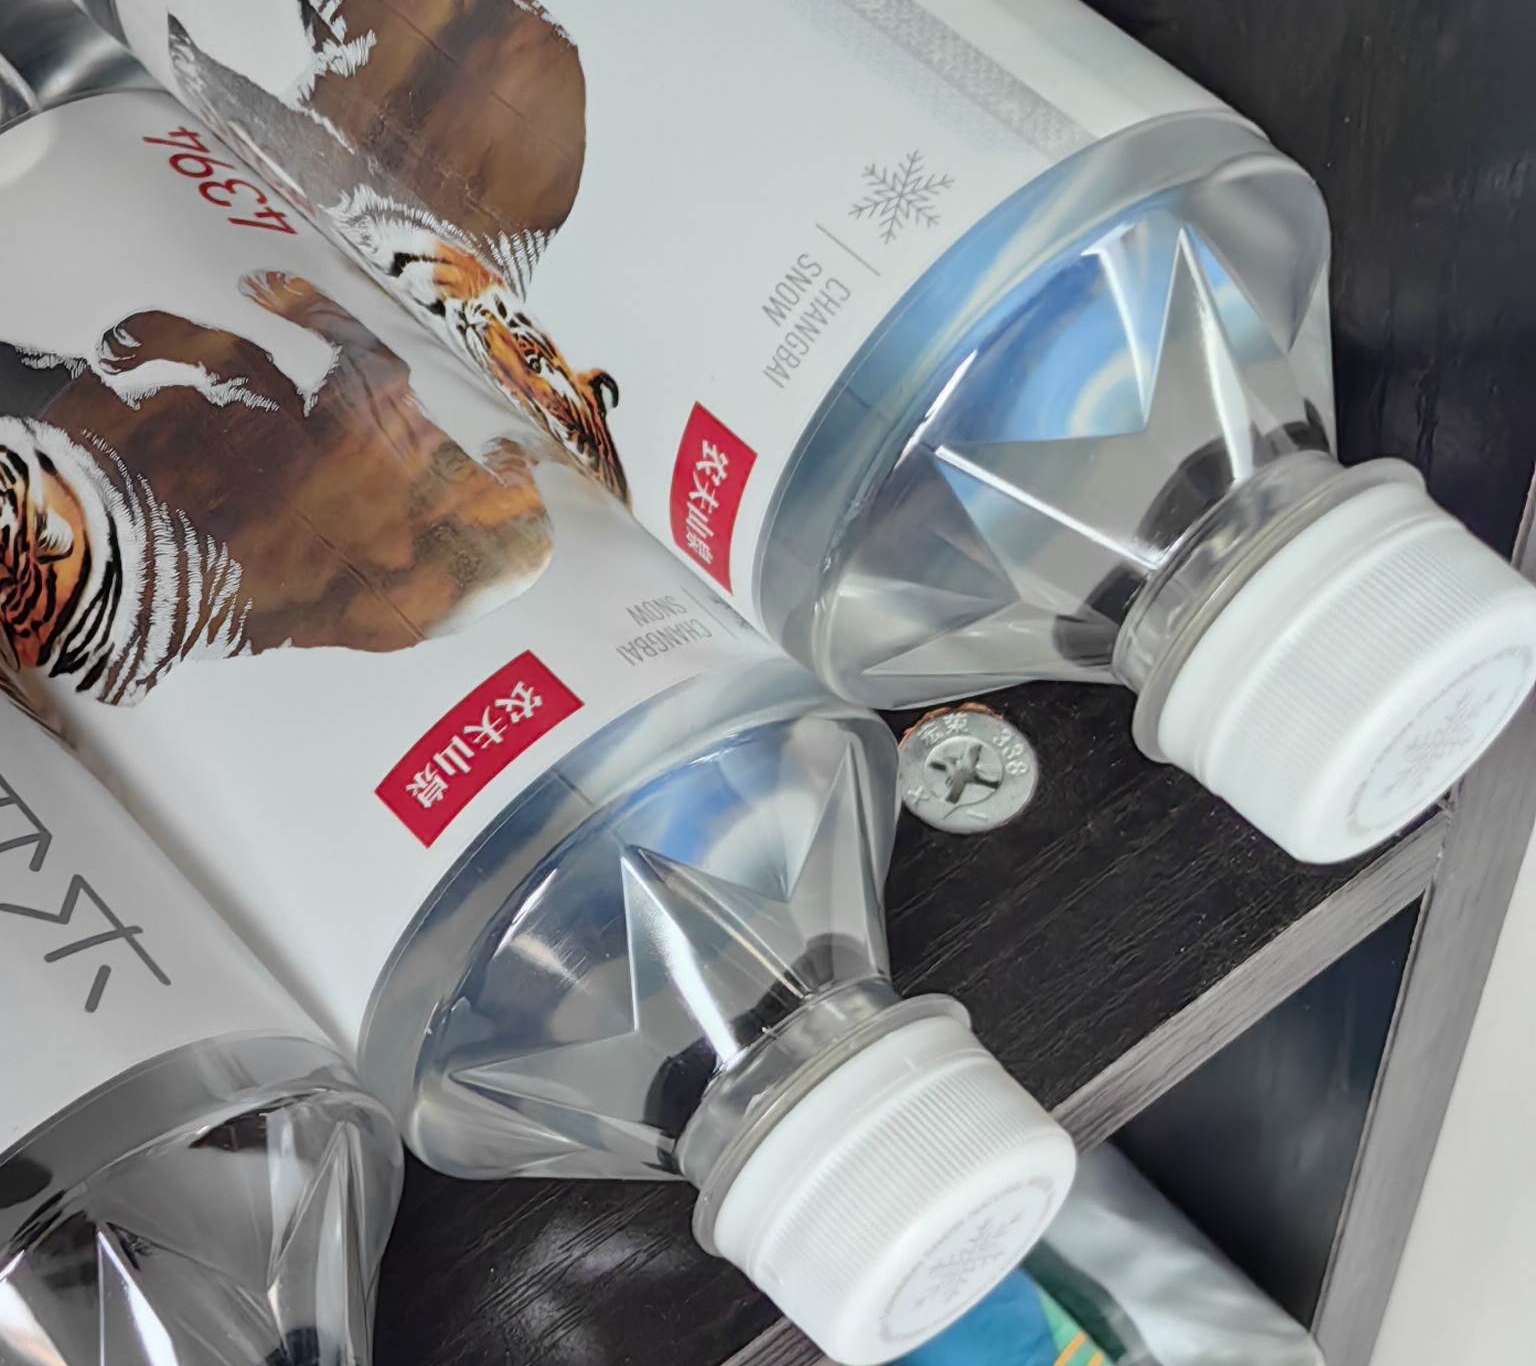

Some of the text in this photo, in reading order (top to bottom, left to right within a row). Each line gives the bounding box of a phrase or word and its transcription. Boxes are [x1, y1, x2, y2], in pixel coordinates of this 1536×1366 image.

[142, 126, 298, 235] 4394
[761, 252, 823, 328] SNOW
[763, 277, 851, 390] CHANGBAI
[685, 438, 731, 566] 农夫山泉
[617, 619, 713, 666] CHANGBAI
[625, 595, 688, 627] SNOW
[405, 681, 544, 809] 农夫山泉
